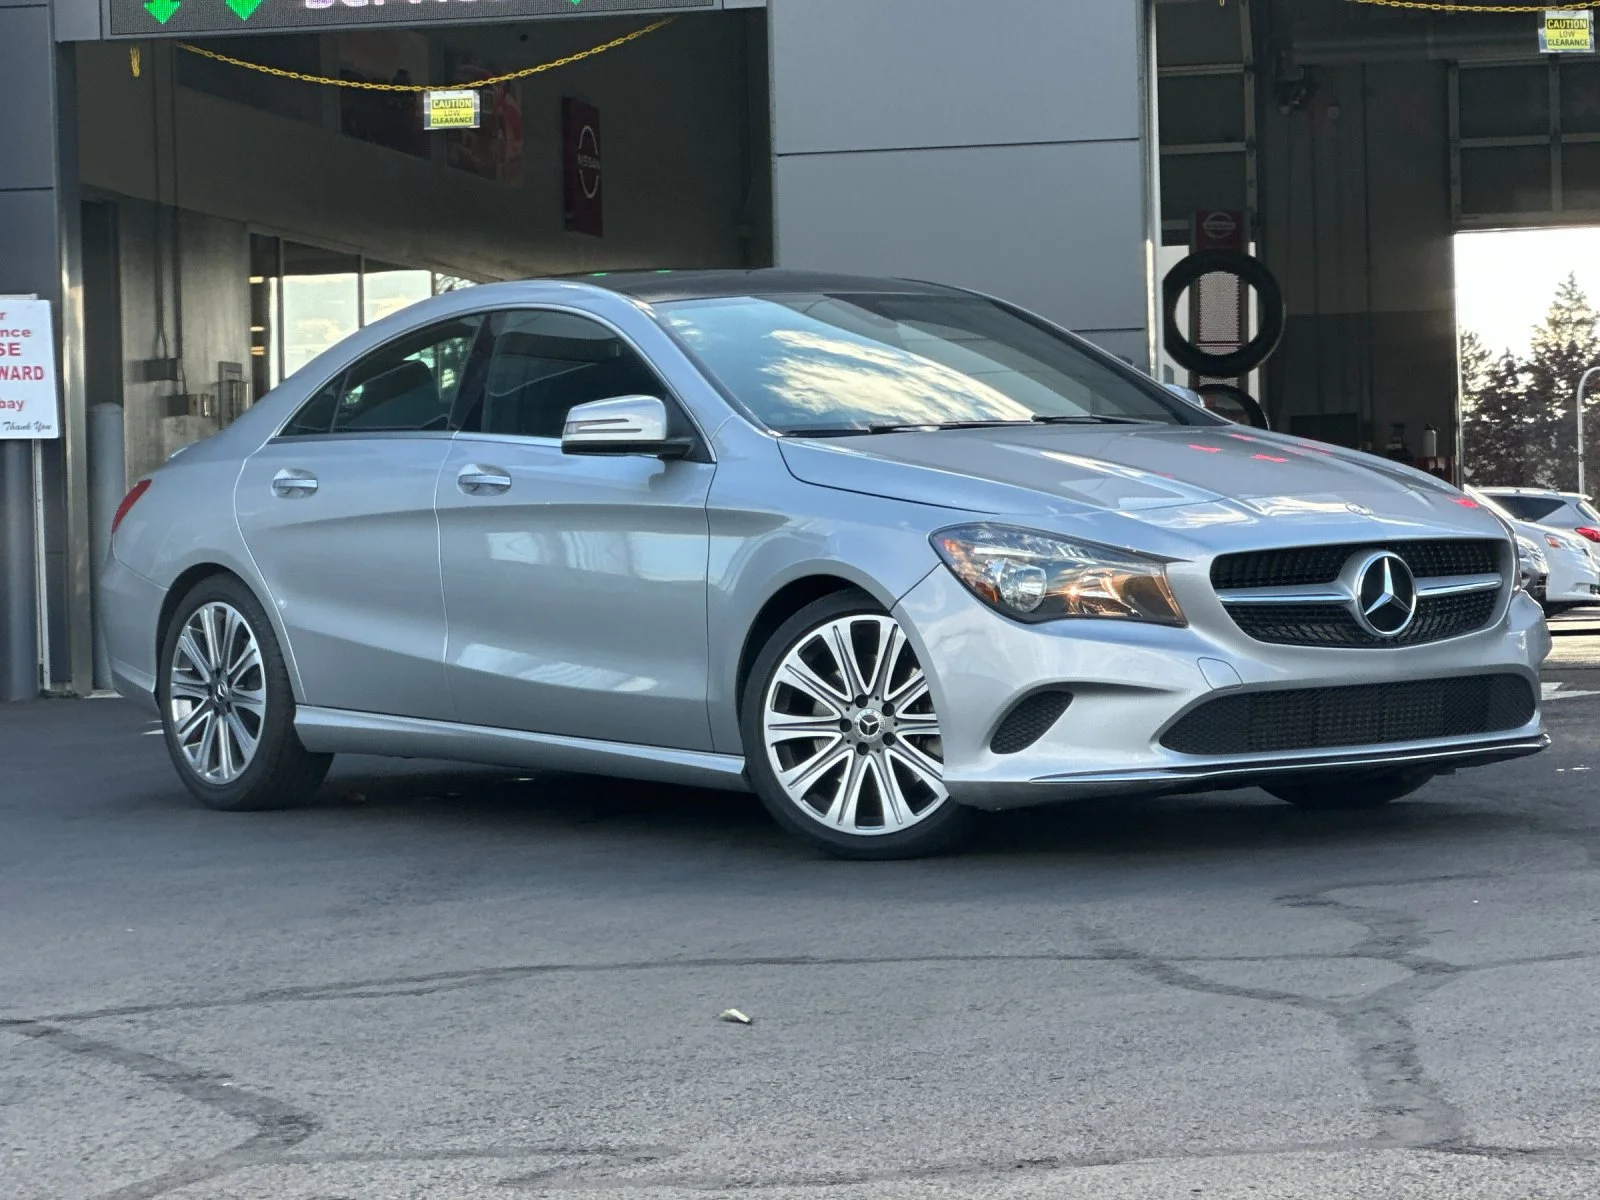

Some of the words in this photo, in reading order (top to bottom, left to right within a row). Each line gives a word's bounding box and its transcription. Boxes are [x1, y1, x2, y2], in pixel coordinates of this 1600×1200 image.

[1547, 19, 1587, 29] CAUTION
[1560, 30, 1576, 38] LOW
[432, 99, 472, 109] CAUTION
[432, 116, 473, 124] CLEARANCE
[3, 421, 31, 431] Thank
[33, 420, 52, 433] You
